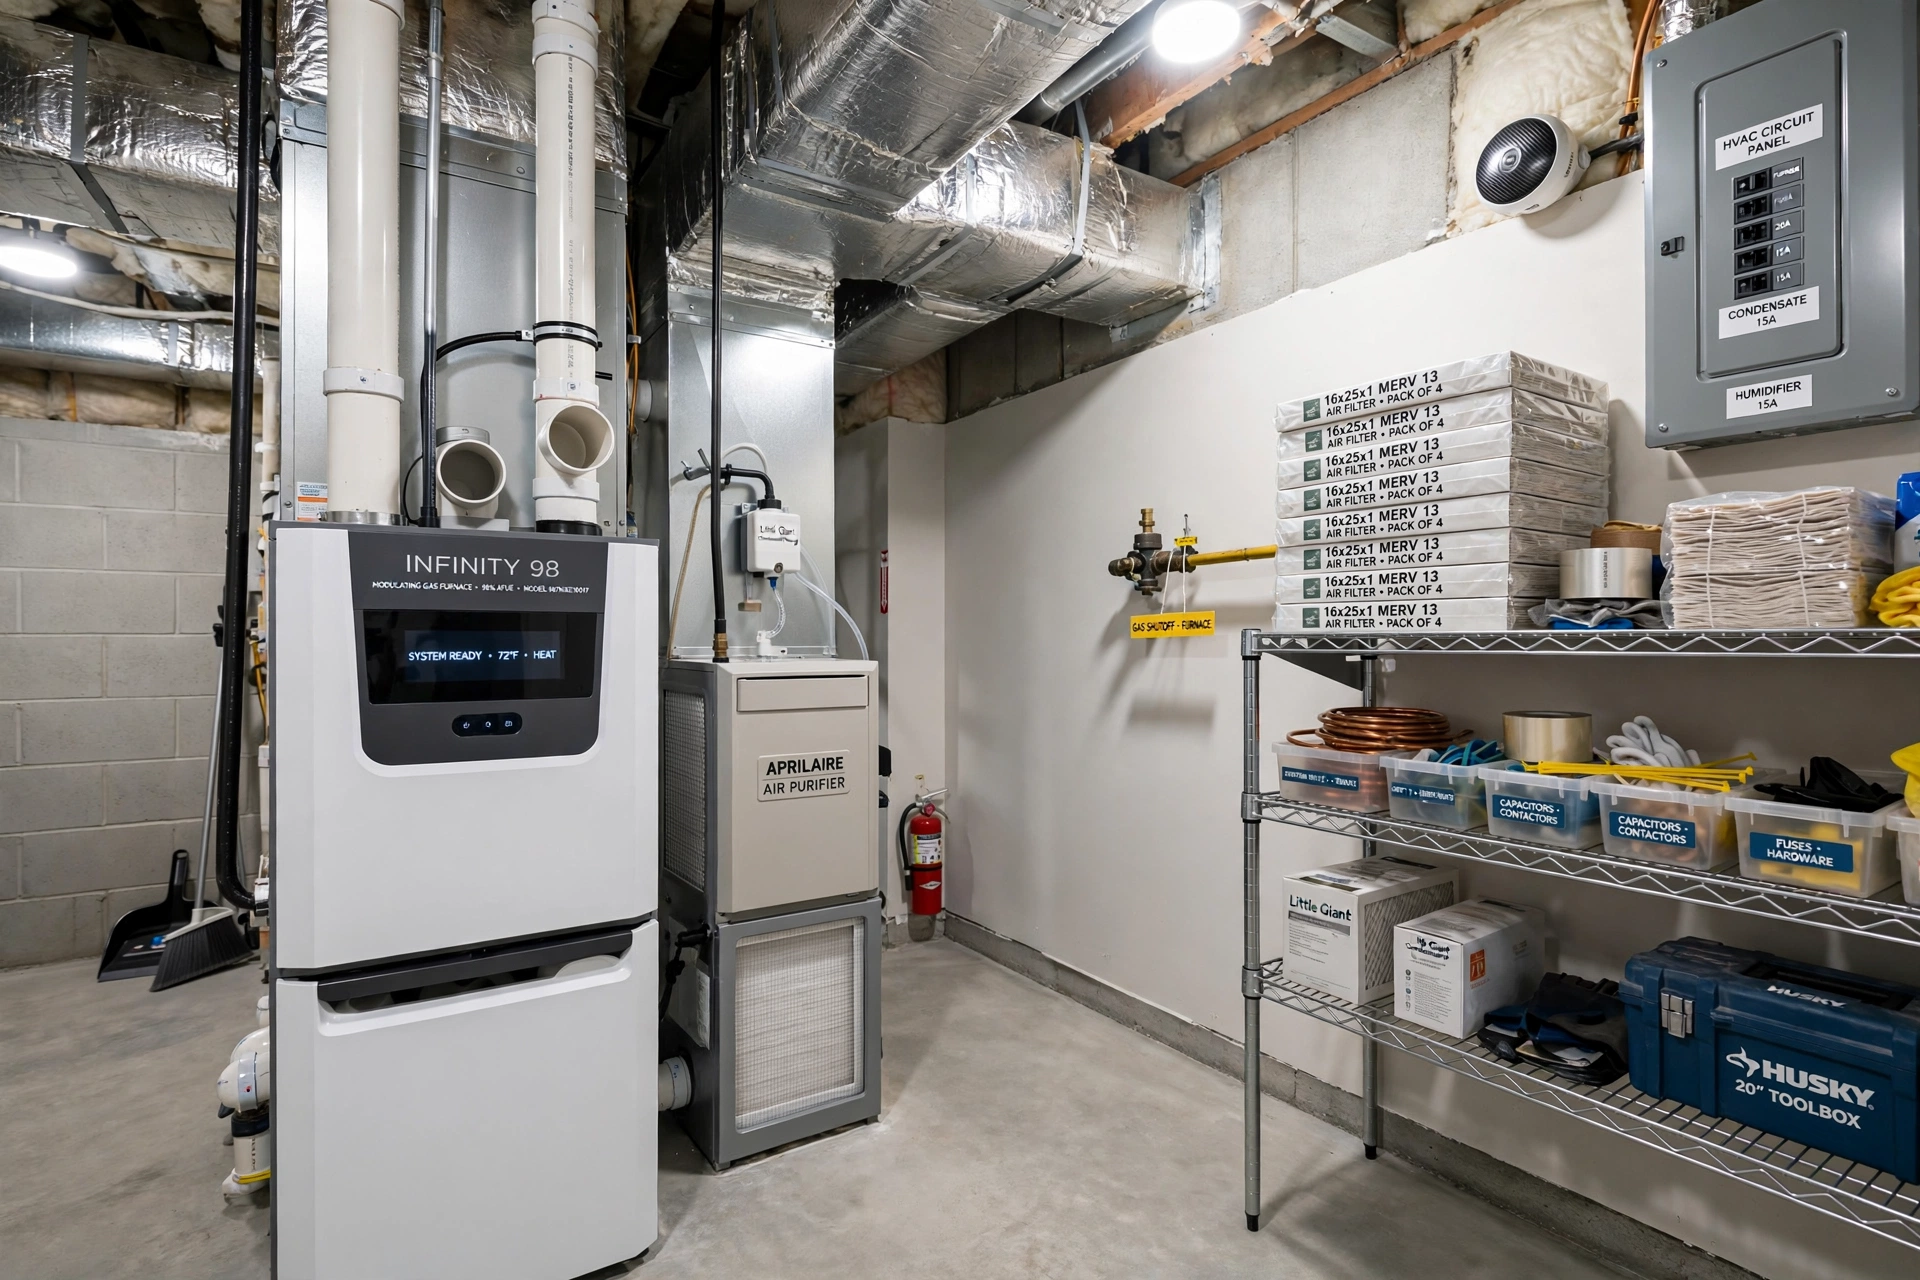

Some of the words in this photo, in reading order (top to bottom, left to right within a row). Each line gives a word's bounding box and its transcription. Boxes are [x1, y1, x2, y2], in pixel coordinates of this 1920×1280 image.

[1723, 131, 1758, 151] HVAC
[1761, 111, 1815, 137] CIRCUIT
[1748, 135, 1791, 155] PANEL
[1776, 271, 1791, 283] 15A
[1728, 294, 1808, 320] CONDENSATE
[1756, 314, 1777, 327] 15A
[1325, 386, 1372, 405] 16x25x1
[1379, 375, 1417, 394] MERV
[1422, 370, 1438, 384] 13
[1735, 380, 1802, 401] HUMIDIFIER
[1326, 406, 1342, 417] AIR
[1345, 399, 1376, 413] FILTER
[1388, 390, 1414, 404] PACK
[1418, 386, 1432, 396] OF
[1436, 383, 1443, 393] 4
[1758, 398, 1778, 410] 15A
[1326, 418, 1374, 437] 16x25x1
[1380, 409, 1418, 427] MERV
[1424, 404, 1440, 418] 13
[1328, 438, 1343, 449] AIR
[1346, 431, 1377, 445] FILTER
[1390, 424, 1416, 437] PACK
[1420, 420, 1433, 431] OF
[1437, 418, 1444, 427] 4
[1325, 450, 1373, 467] 16x25x1
[1379, 441, 1418, 458] MERV
[1424, 438, 1439, 450] 13
[1326, 468, 1342, 478] AIR
[1345, 461, 1376, 475] FILTER
[1388, 456, 1415, 469] PACK
[1418, 453, 1433, 463] OF
[1436, 451, 1443, 460] 4
[1325, 481, 1373, 498] 16x25x1
[1379, 474, 1417, 490] MERV
[1423, 471, 1439, 483] 13
[1326, 498, 1342, 508] AIR
[1345, 494, 1376, 505] FILTER
[1388, 487, 1414, 500] PACK
[1418, 486, 1432, 497] OF
[1436, 484, 1443, 493] 4
[1325, 512, 1373, 527] 16x25x1
[1379, 506, 1417, 522] MERV
[1423, 504, 1438, 516] 13
[1326, 529, 1342, 538] AIR
[1345, 525, 1376, 536] FILTER
[1388, 521, 1414, 532] PACK
[1418, 519, 1432, 529] OF
[1436, 518, 1443, 526] 4
[1325, 544, 1374, 557] 16x25x1
[1379, 540, 1418, 553] MERV
[1424, 538, 1439, 549] 13
[406, 554, 520, 576] INFINITY
[530, 559, 560, 578] 98
[1326, 560, 1342, 569] AIR
[1345, 557, 1376, 567] FILTER
[1388, 554, 1415, 564] PACK
[1418, 553, 1432, 562] OF
[1436, 552, 1443, 560] 4
[422, 582, 438, 590] GAS
[440, 582, 472, 590] FURNACE
[497, 584, 514, 592] AFUE
[1325, 574, 1373, 587] 16x25x1
[1379, 572, 1417, 585] MERV
[1423, 570, 1438, 582] 13
[1326, 589, 1342, 598] AIR
[1345, 588, 1376, 597] FILTER
[1388, 586, 1414, 596] PACK
[1418, 585, 1432, 594] OF
[1436, 584, 1443, 593] 4
[1324, 606, 1372, 617] 16x25x1
[1378, 604, 1416, 616] MERV
[1422, 604, 1438, 615] 13
[1132, 622, 1145, 632] GAS
[1147, 620, 1175, 631] SHUTOFF
[1181, 619, 1212, 630] FURNACE
[1325, 620, 1341, 628] AIR
[1344, 619, 1375, 628] FILTER
[1387, 618, 1413, 628] PACK
[1417, 618, 1431, 627] OF
[1435, 617, 1442, 627] 4
[408, 651, 447, 661] SYSTEM
[449, 650, 483, 661] READY
[498, 650, 519, 660] 72°F
[533, 650, 557, 660] HEAT
[766, 756, 844, 776] APRILAIRE
[763, 782, 785, 795] AIR
[789, 776, 845, 793] PURIFIER
[1500, 798, 1555, 814] CAPACITORS
[1499, 808, 1558, 825] CONTACTORS
[1617, 815, 1682, 833] CAPACITORS
[1617, 825, 1687, 844] CONTACTORS
[1775, 838, 1813, 852] FUSES
[1766, 848, 1834, 868] HARDWARE
[1289, 894, 1318, 913] Little
[1320, 903, 1352, 921] Giant
[1767, 985, 1847, 1008] HUSKY
[1762, 1059, 1875, 1109] HUSKY
[1768, 1088, 1862, 1130] TOOLBOX
